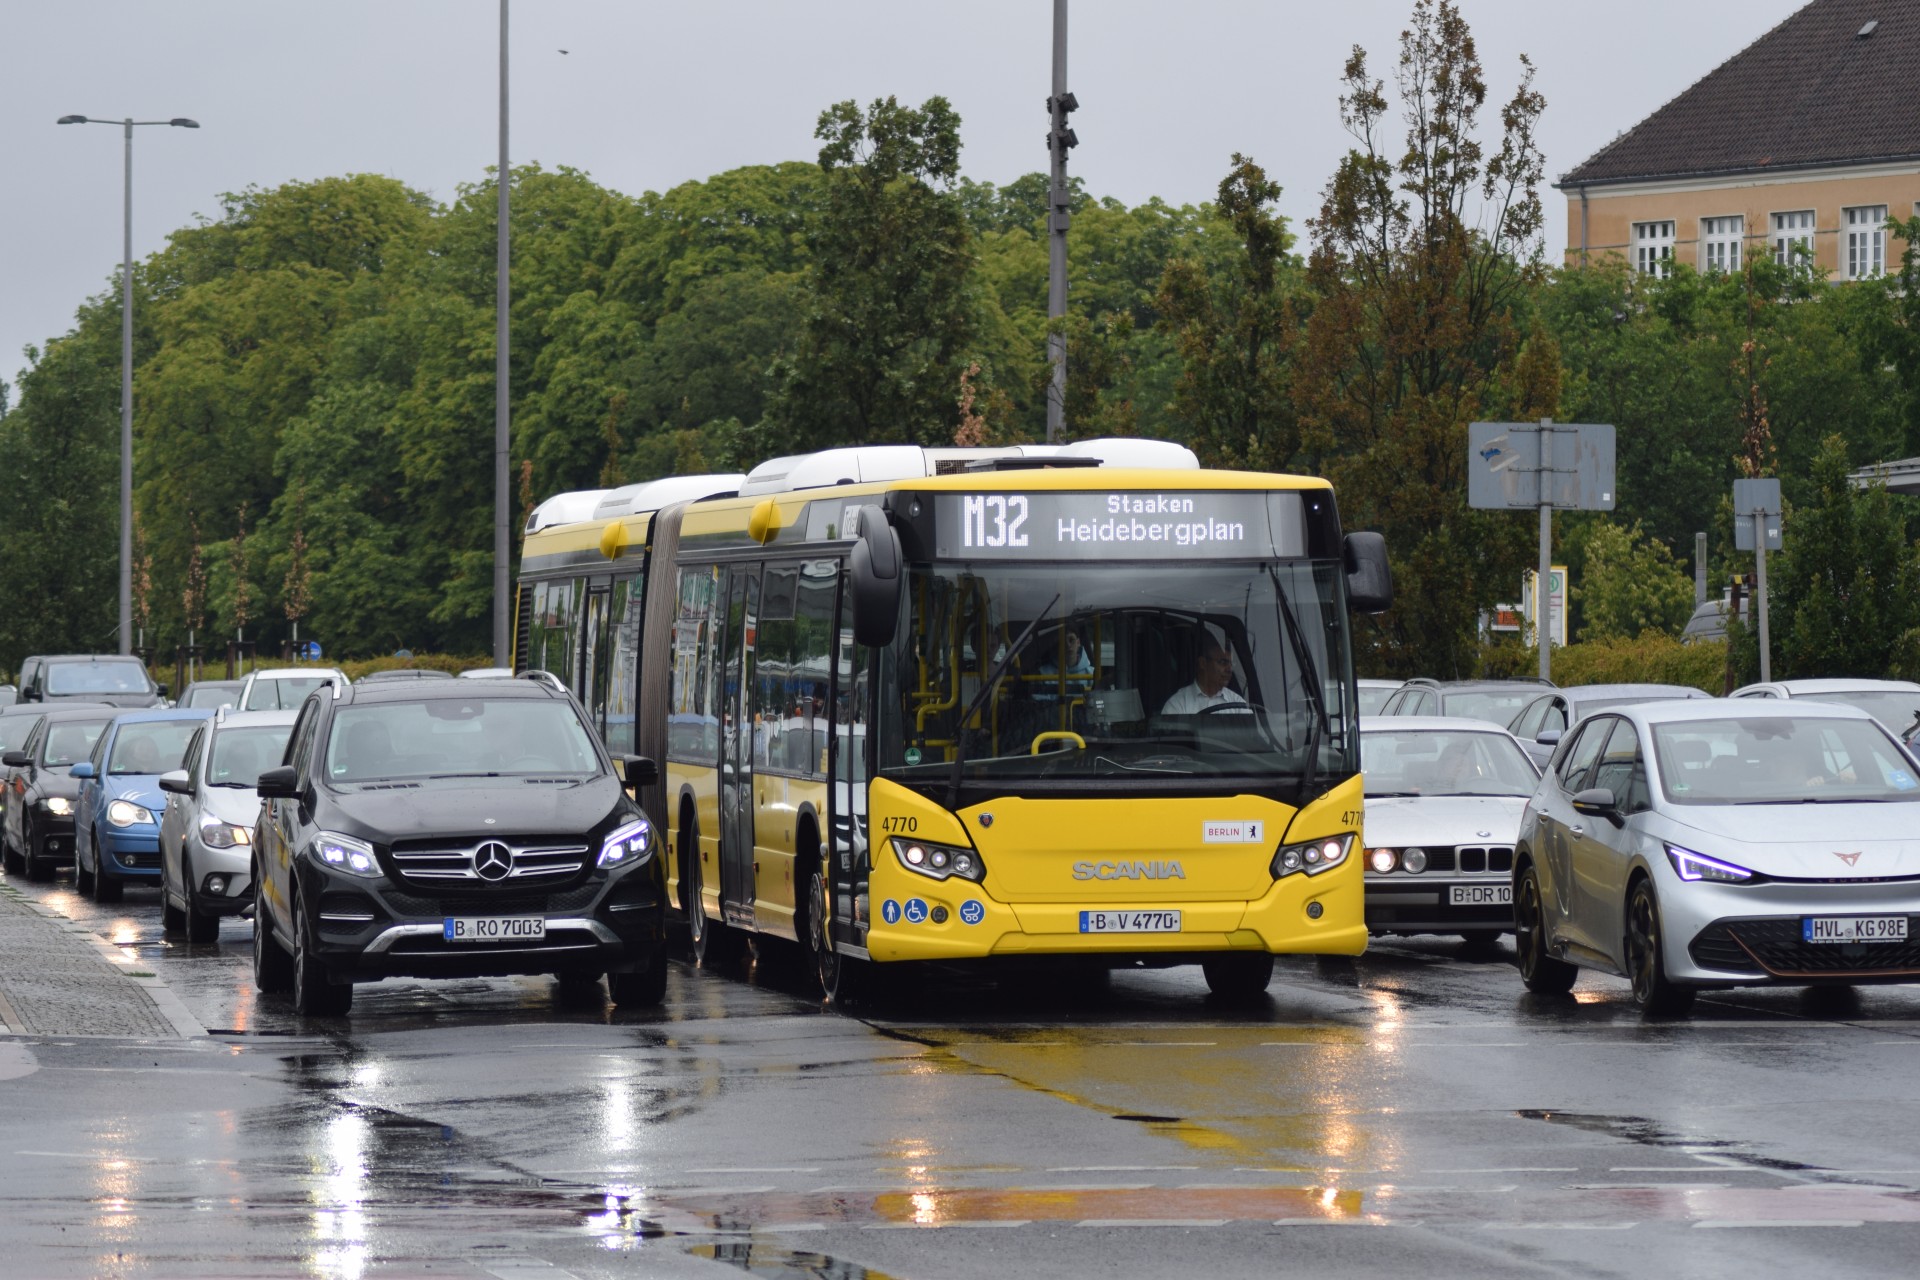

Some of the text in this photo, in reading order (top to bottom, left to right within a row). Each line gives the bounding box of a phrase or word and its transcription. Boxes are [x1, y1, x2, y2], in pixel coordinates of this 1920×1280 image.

[1107, 495, 1194, 514] Staaken
[963, 495, 1029, 547] M32
[1057, 518, 1244, 546] Heidebergplan
[881, 816, 918, 833] 4770
[1208, 827, 1240, 836] BERLIN
[1071, 860, 1186, 881] SCANIA
[501, 919, 543, 936] 7003
[1132, 913, 1174, 930] 4770
[1814, 920, 1844, 938] HVL
[1855, 920, 1875, 937] KG
[1878, 919, 1906, 937] 98E
